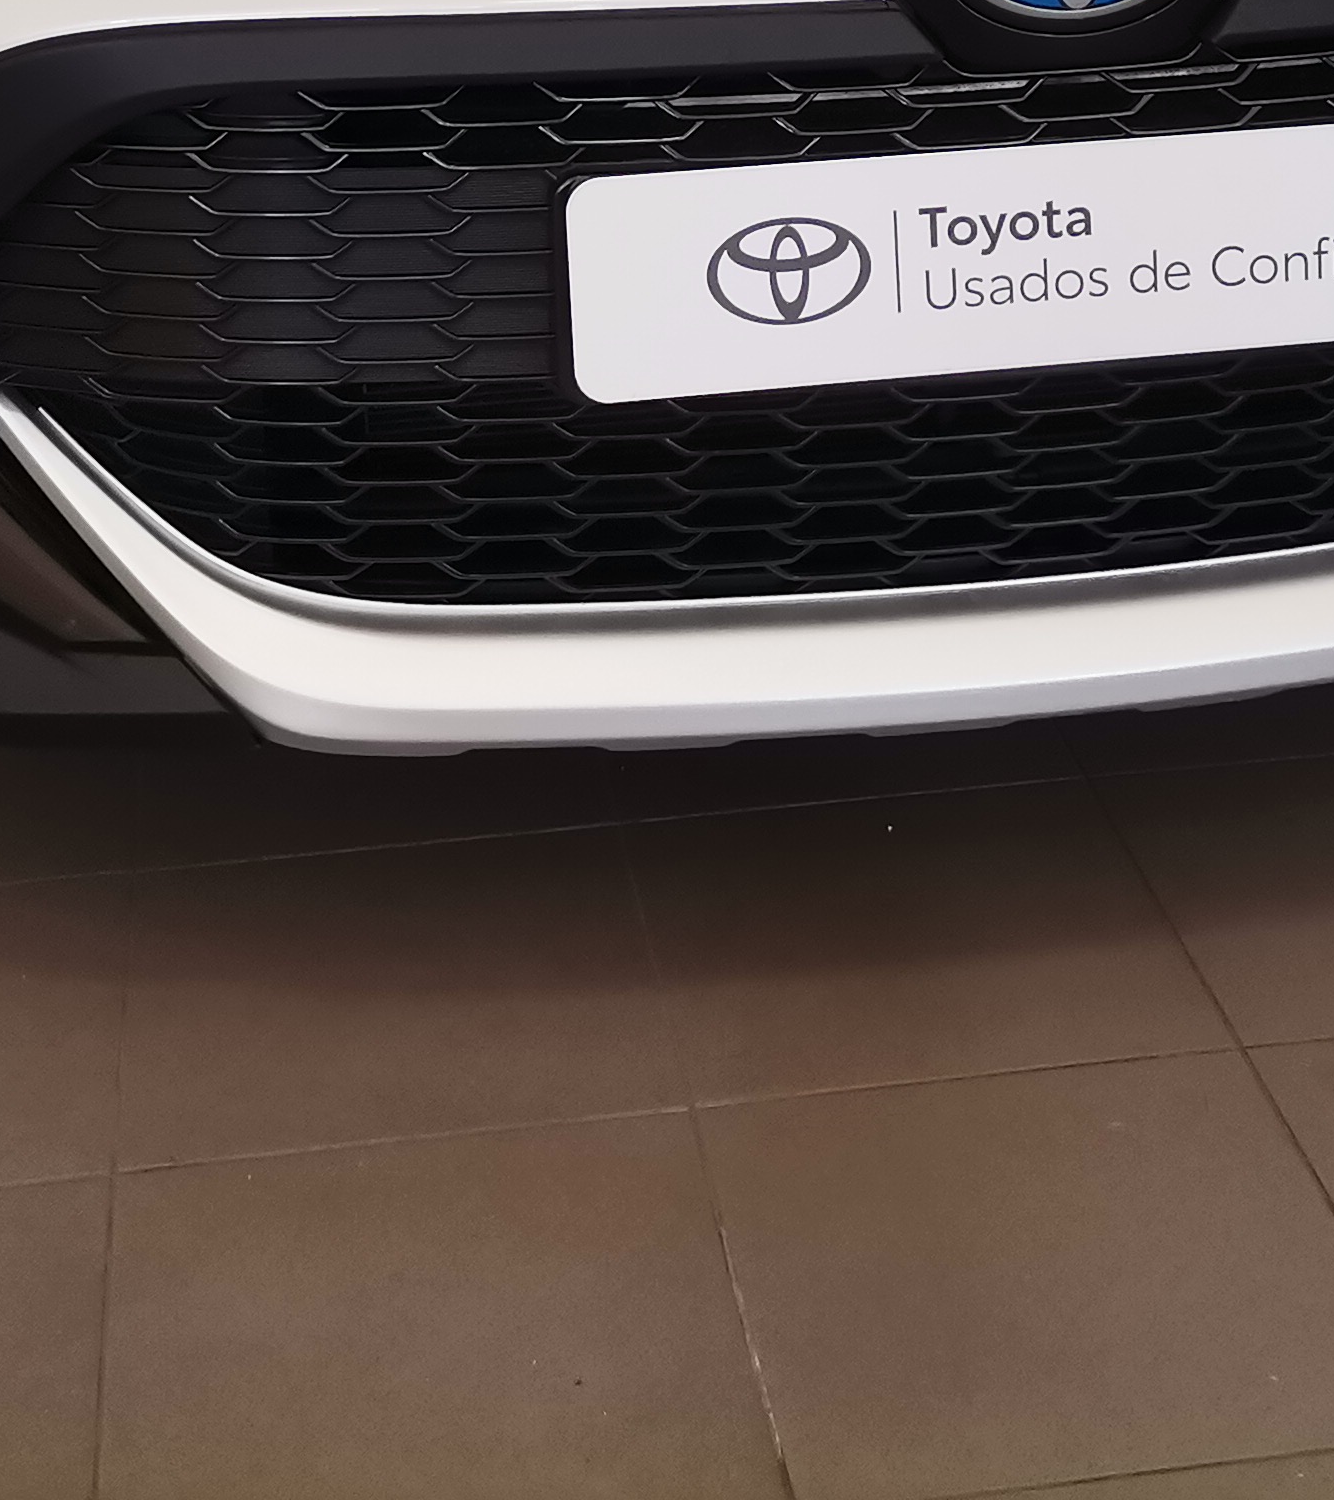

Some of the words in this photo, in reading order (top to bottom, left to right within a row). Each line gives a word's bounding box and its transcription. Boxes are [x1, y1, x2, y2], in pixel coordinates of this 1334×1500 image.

[918, 200, 1093, 256] Toyota
[924, 257, 1110, 310] Usados
[1129, 249, 1192, 294] de
